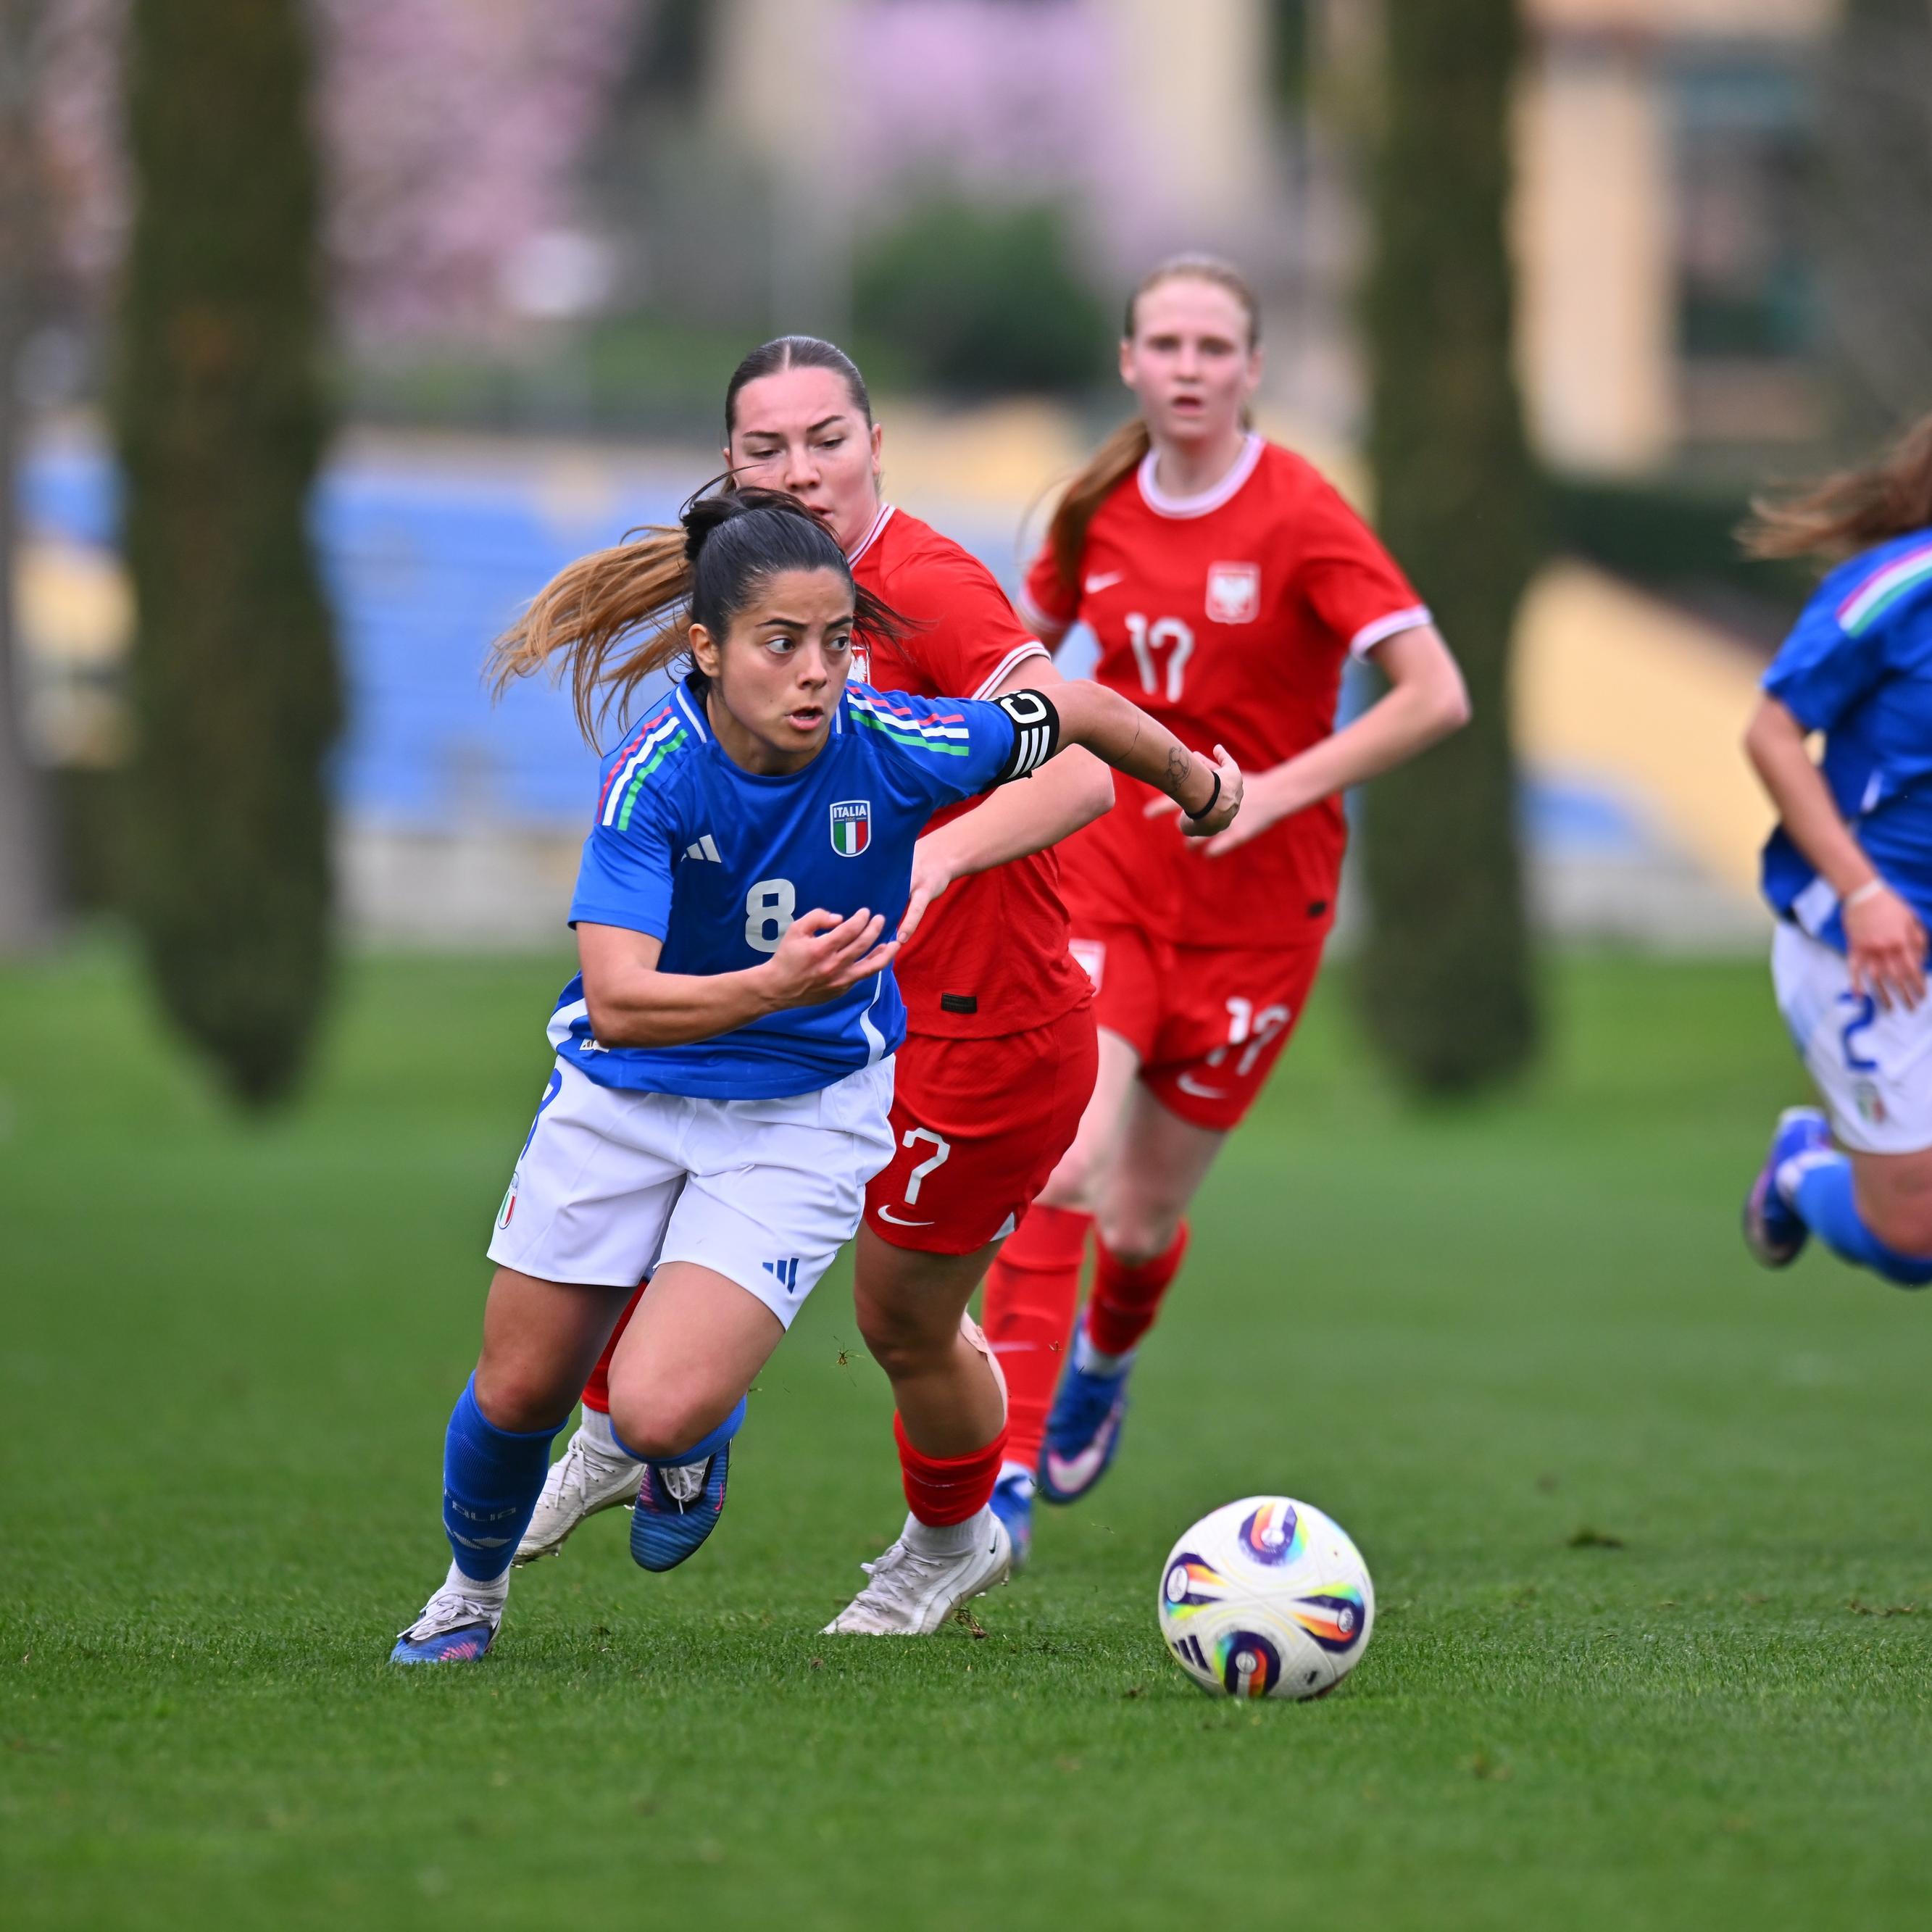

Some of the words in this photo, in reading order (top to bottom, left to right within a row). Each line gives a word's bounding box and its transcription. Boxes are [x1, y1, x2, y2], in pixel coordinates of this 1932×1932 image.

[1125, 612, 1194, 703] 17
[1000, 693, 1047, 724] C
[833, 804, 867, 818] ITALIA
[745, 878, 796, 953] 8
[1836, 993, 1877, 1072] 2
[902, 1127, 951, 1205] 7
[445, 1490, 516, 1521] ALIA
